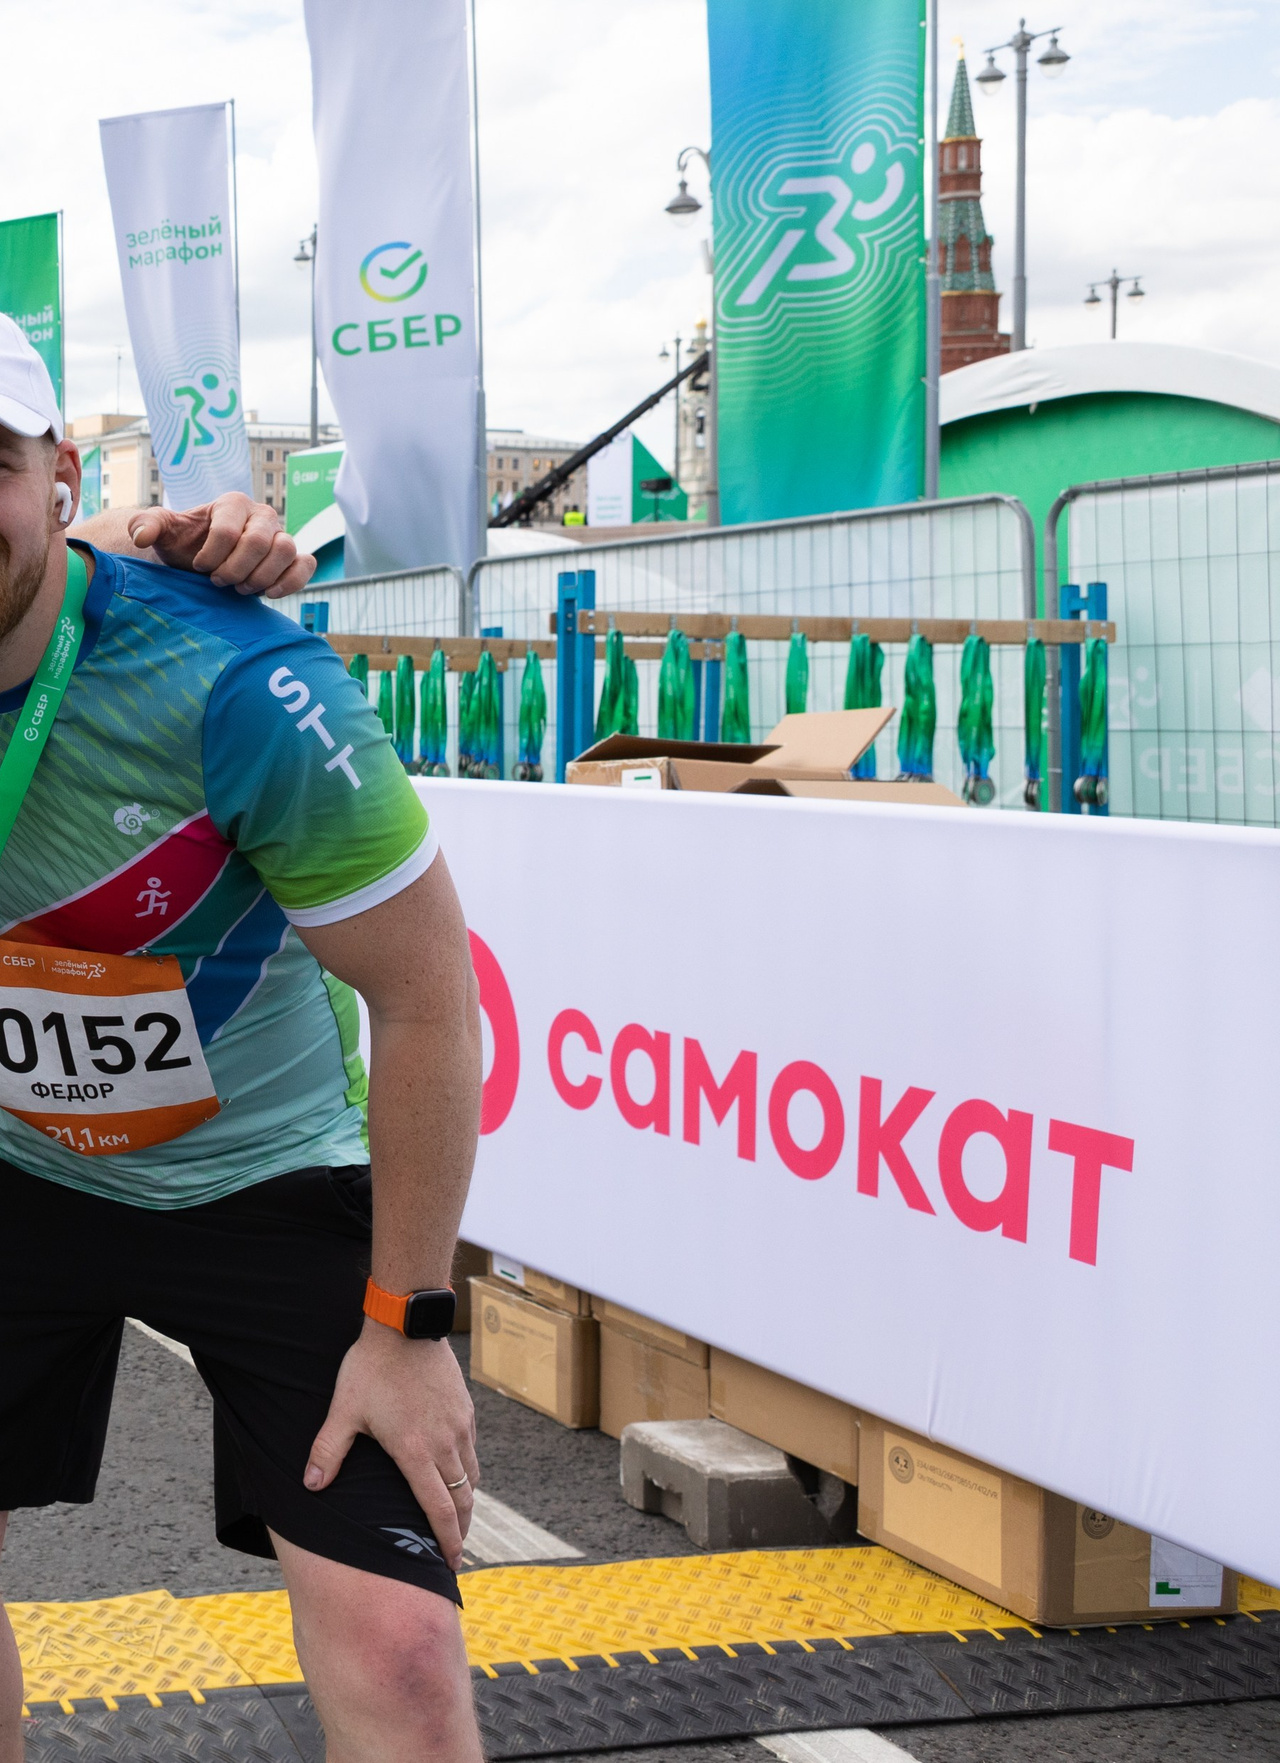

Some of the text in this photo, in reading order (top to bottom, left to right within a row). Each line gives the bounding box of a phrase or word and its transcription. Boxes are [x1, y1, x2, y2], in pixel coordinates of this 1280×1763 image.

[126, 215, 222, 248] зелёный
[128, 240, 223, 269] марафон
[332, 313, 462, 356] СБЕР
[47, 634, 65, 673] зелёный
[53, 640, 72, 680] марафон
[31, 693, 48, 725] СБЕР
[268, 666, 362, 790] STT
[3, 955, 36, 968] СБЕР
[51, 967, 87, 977] марафон
[54, 960, 88, 969] зелёный
[31, 1082, 114, 1102] ФЕДОР
[45, 1126, 94, 1151] 21,1
[547, 1008, 1135, 1267] самокат
